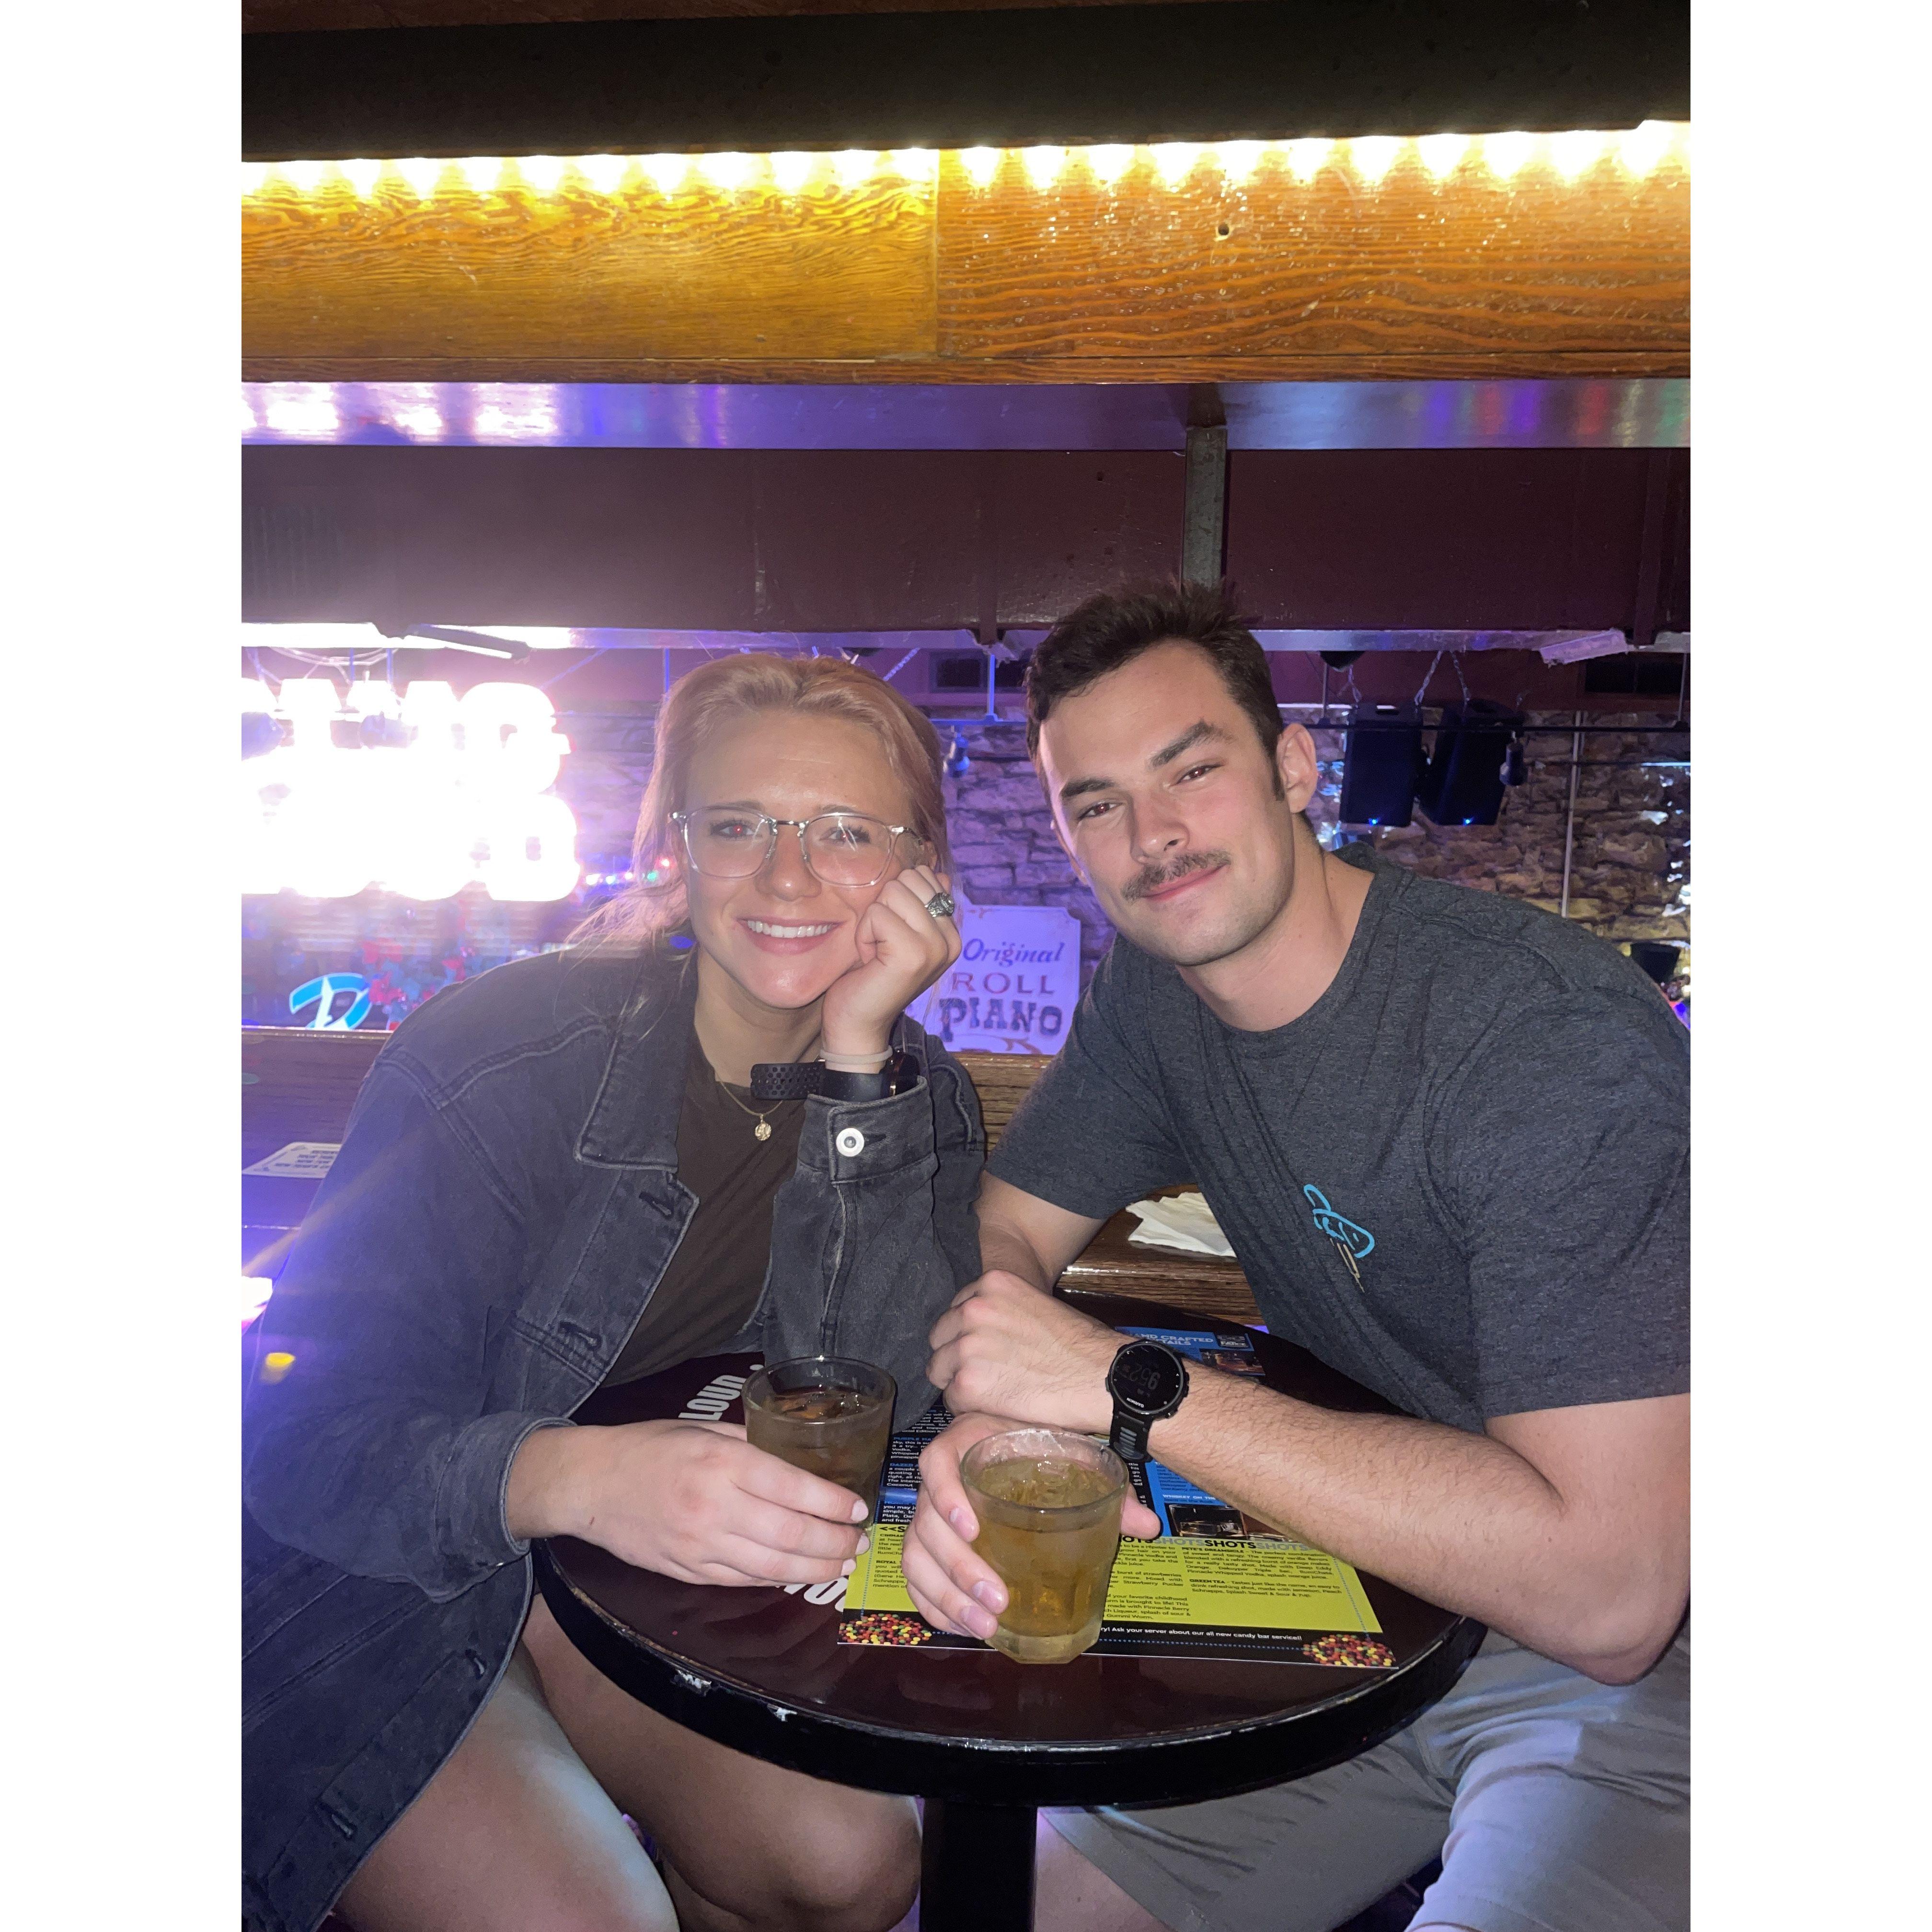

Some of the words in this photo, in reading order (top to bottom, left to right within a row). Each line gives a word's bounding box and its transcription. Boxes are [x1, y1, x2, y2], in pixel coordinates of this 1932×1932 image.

[963, 939, 1065, 967] Original
[951, 972, 1056, 994] ROLL
[939, 997, 1063, 1042] PIANO
[1127, 1397, 1144, 1408] GARMIN
[1205, 1540, 1256, 1549] SHOTS
